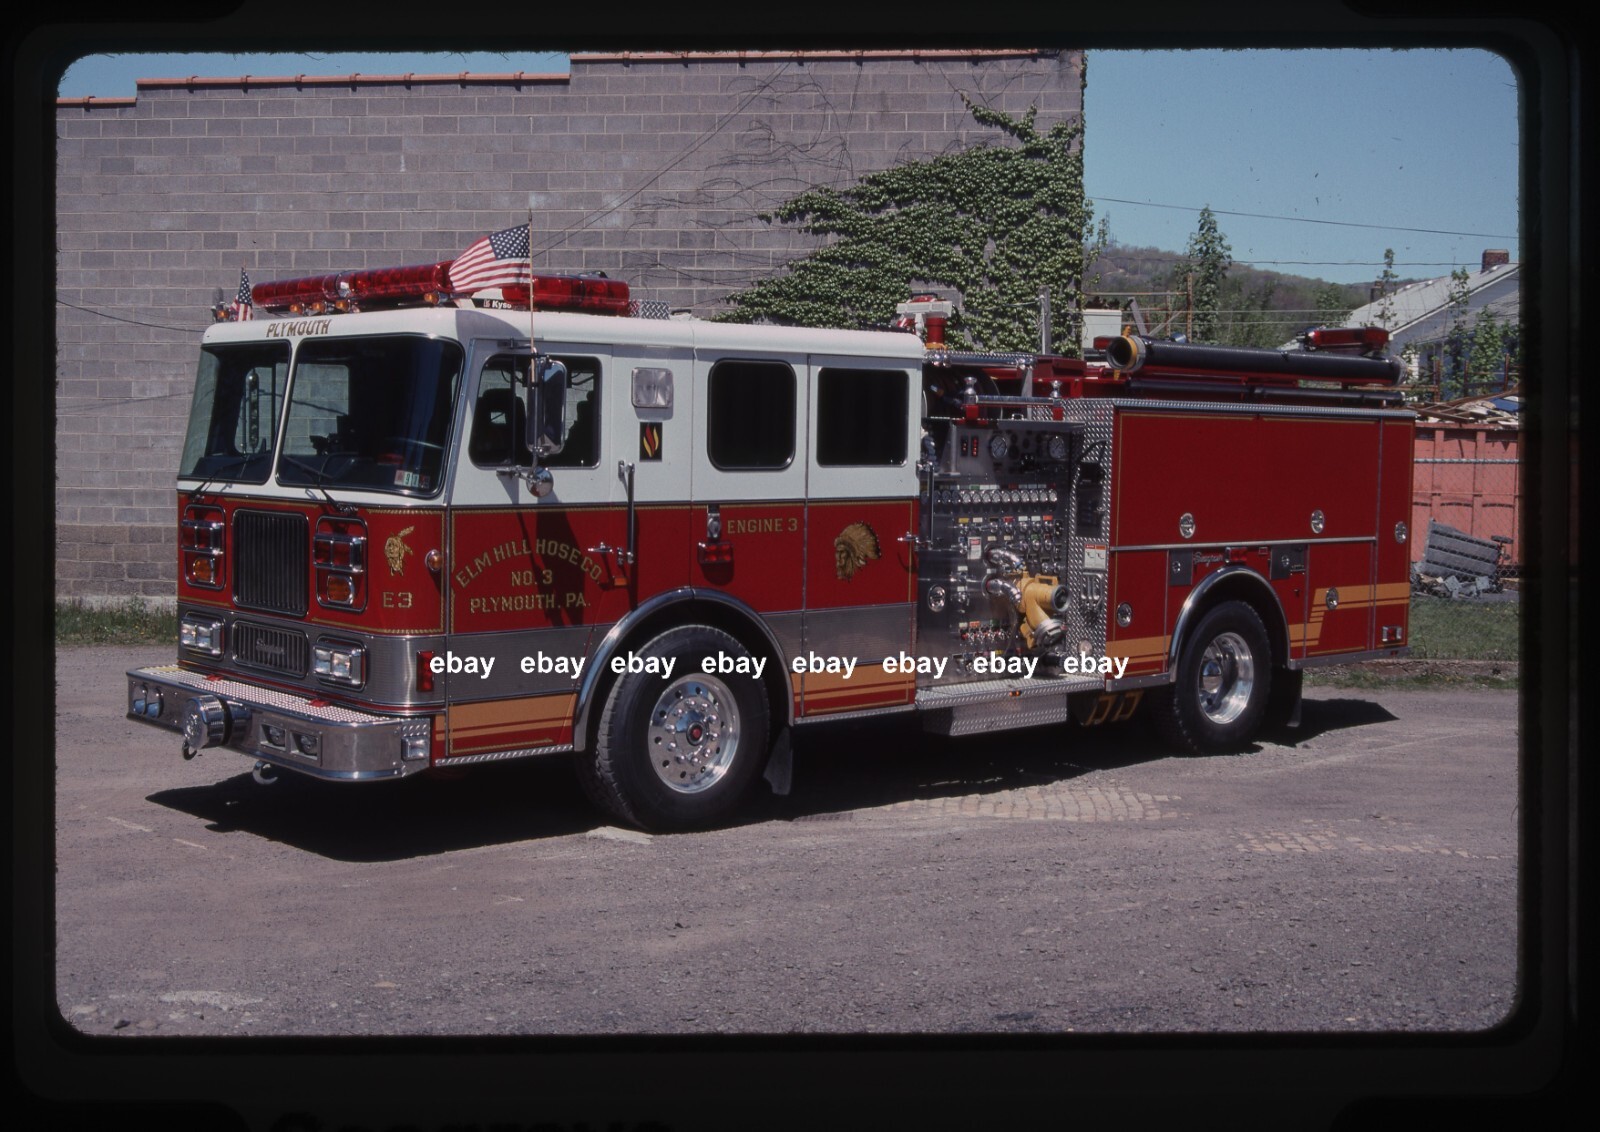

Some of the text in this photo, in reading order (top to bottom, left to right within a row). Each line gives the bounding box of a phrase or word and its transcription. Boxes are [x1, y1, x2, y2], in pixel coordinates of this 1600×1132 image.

[266, 319, 332, 338] PLYMOUTH
[727, 517, 798, 534] ENGINE 3
[455, 552, 493, 588] ELM
[493, 539, 532, 563] HILL
[535, 538, 582, 565] HOSE
[511, 569, 553, 587] NO. 3
[382, 591, 413, 608] E3
[565, 592, 591, 609] PA.
